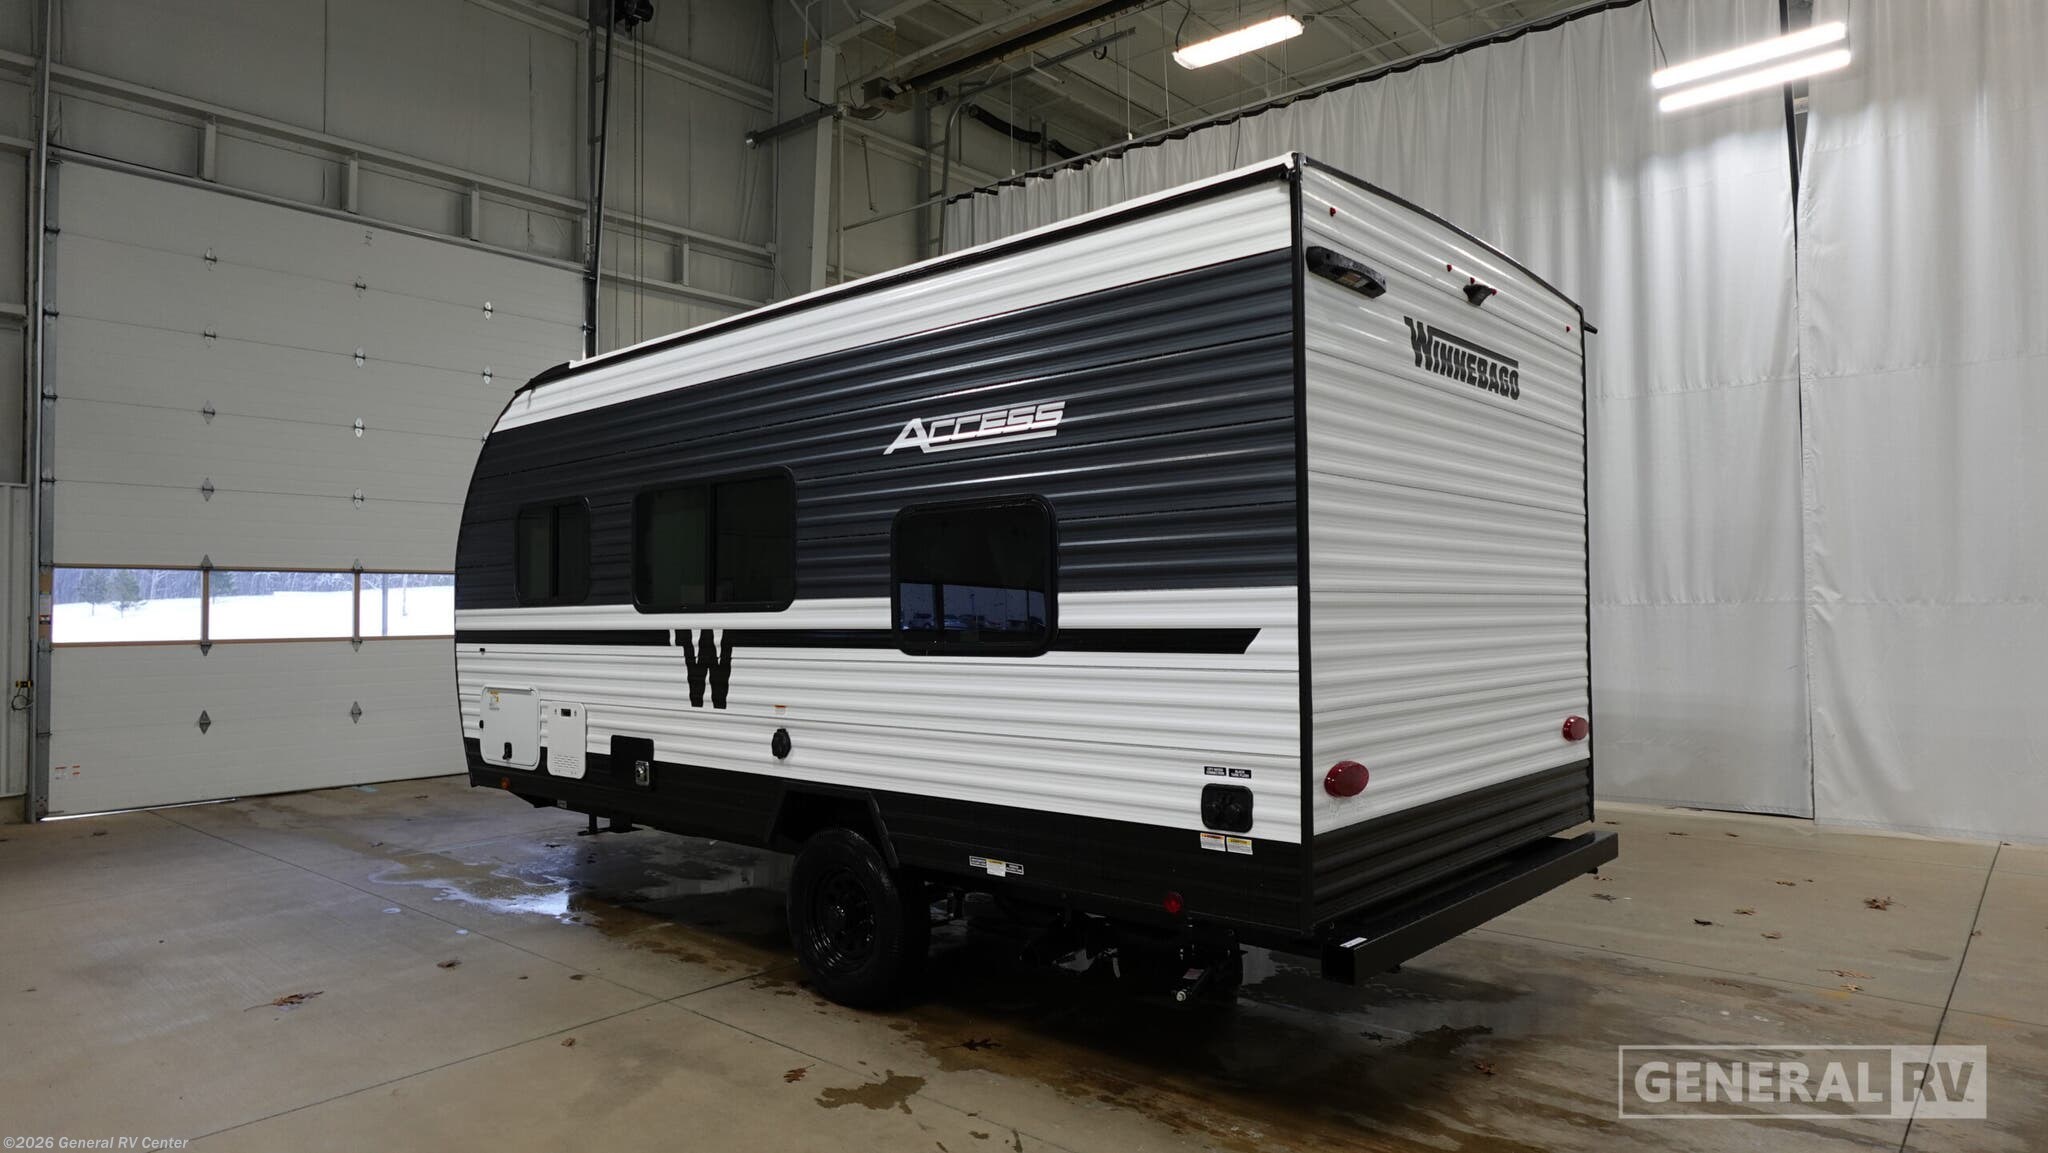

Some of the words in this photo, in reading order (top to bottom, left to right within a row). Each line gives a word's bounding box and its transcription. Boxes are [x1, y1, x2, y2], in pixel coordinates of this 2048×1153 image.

[1403, 316, 1520, 400] WINNEBAGO
[883, 401, 1066, 455] ACCESS
[674, 629, 733, 709] W
